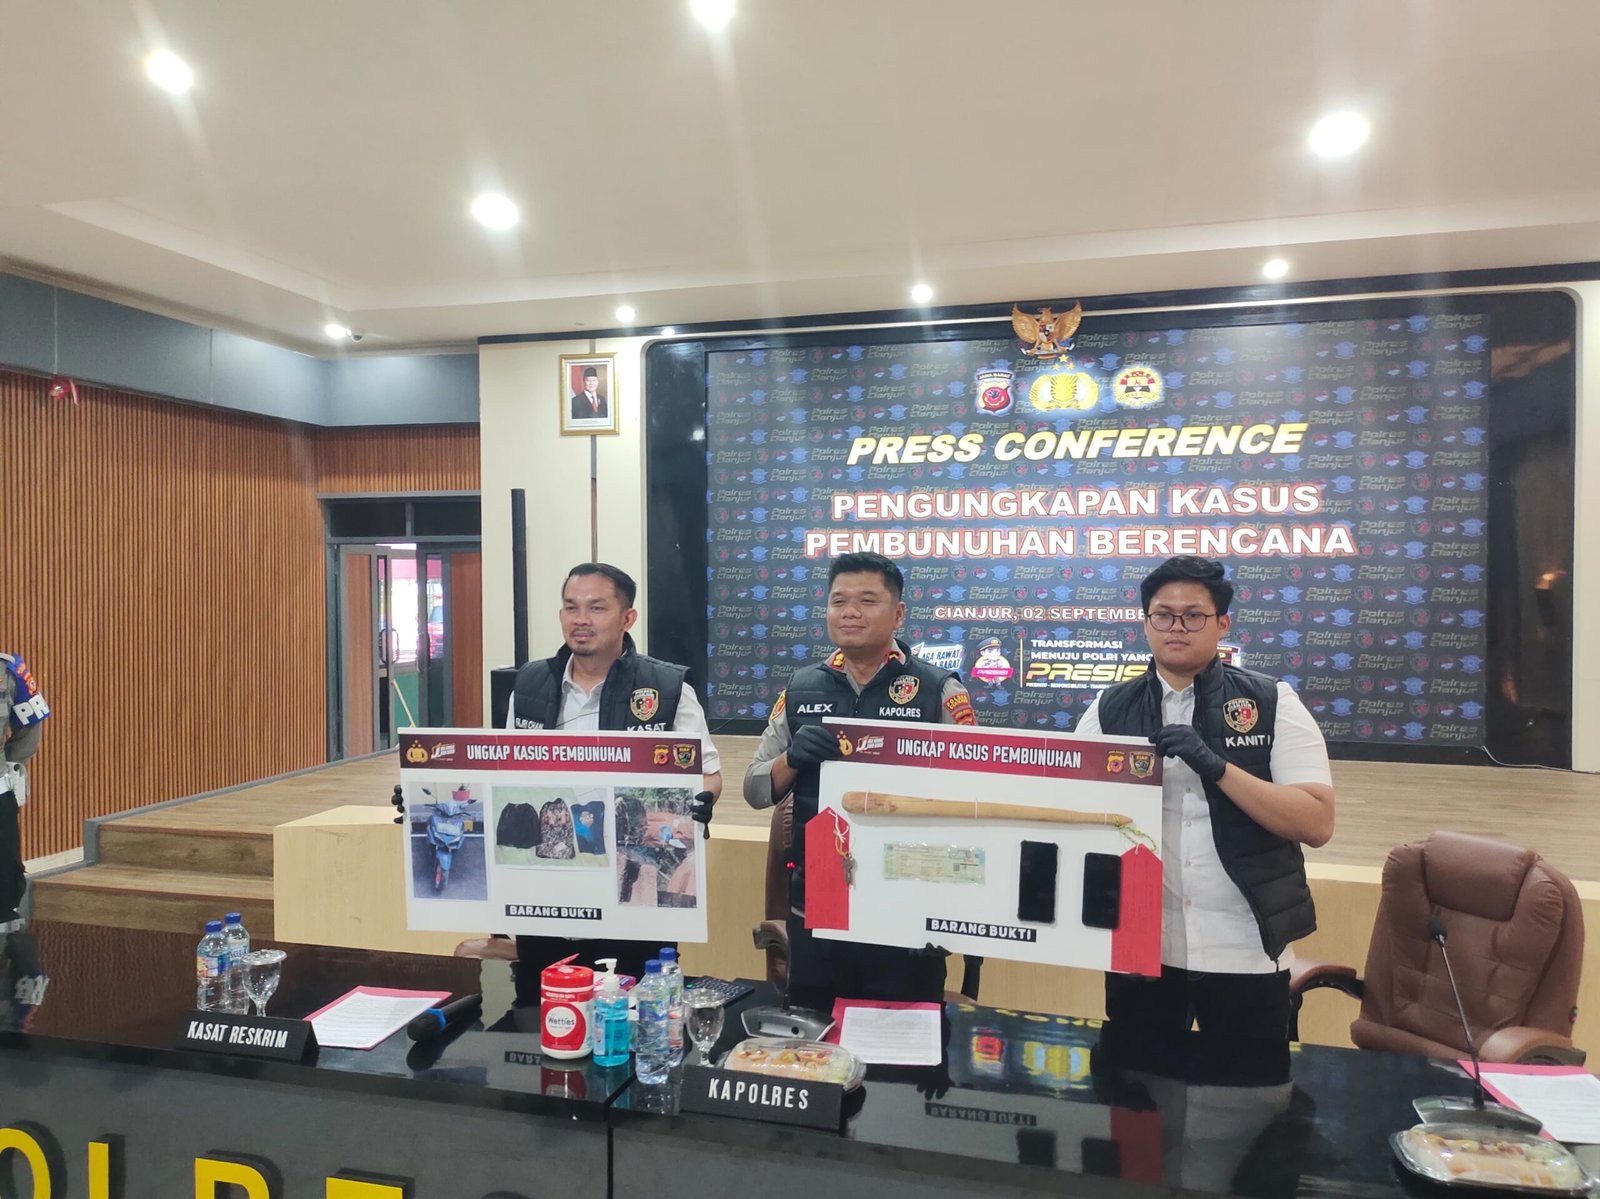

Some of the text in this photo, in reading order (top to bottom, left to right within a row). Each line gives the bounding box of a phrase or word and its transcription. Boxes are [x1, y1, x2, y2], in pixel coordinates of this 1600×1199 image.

[847, 423, 1308, 465] PRESS CONFERENCE
[834, 486, 1320, 519] PENGUNGKAPAN KASUS
[806, 527, 1355, 556] PEMBUNUHAN BERENCANA
[935, 607, 1146, 620] CIANJUR, 02 SEPTEMBE
[1030, 640, 1122, 648] TRANSFORMASI
[1031, 652, 1080, 660] MENUJU
[1082, 652, 1118, 660] POLRI
[1026, 662, 1148, 682] PRESIS
[797, 704, 832, 714] ALEX
[880, 706, 920, 718] KAPOLRES
[1225, 735, 1264, 748] KANIT
[467, 744, 510, 760] UNGKAP
[513, 746, 550, 760] KASUS
[552, 746, 631, 762] PEMBUNUHAN
[897, 738, 945, 758] UNGKAP
[948, 742, 988, 761] KASUS
[992, 745, 1082, 768] PEMBUNUHAN
[510, 906, 598, 918] BARANG BUKTI
[931, 920, 1032, 940] BARANG BUKTI
[188, 1020, 288, 1048] KASAT RESKRIM
[708, 1078, 808, 1110] KAPOLRES
